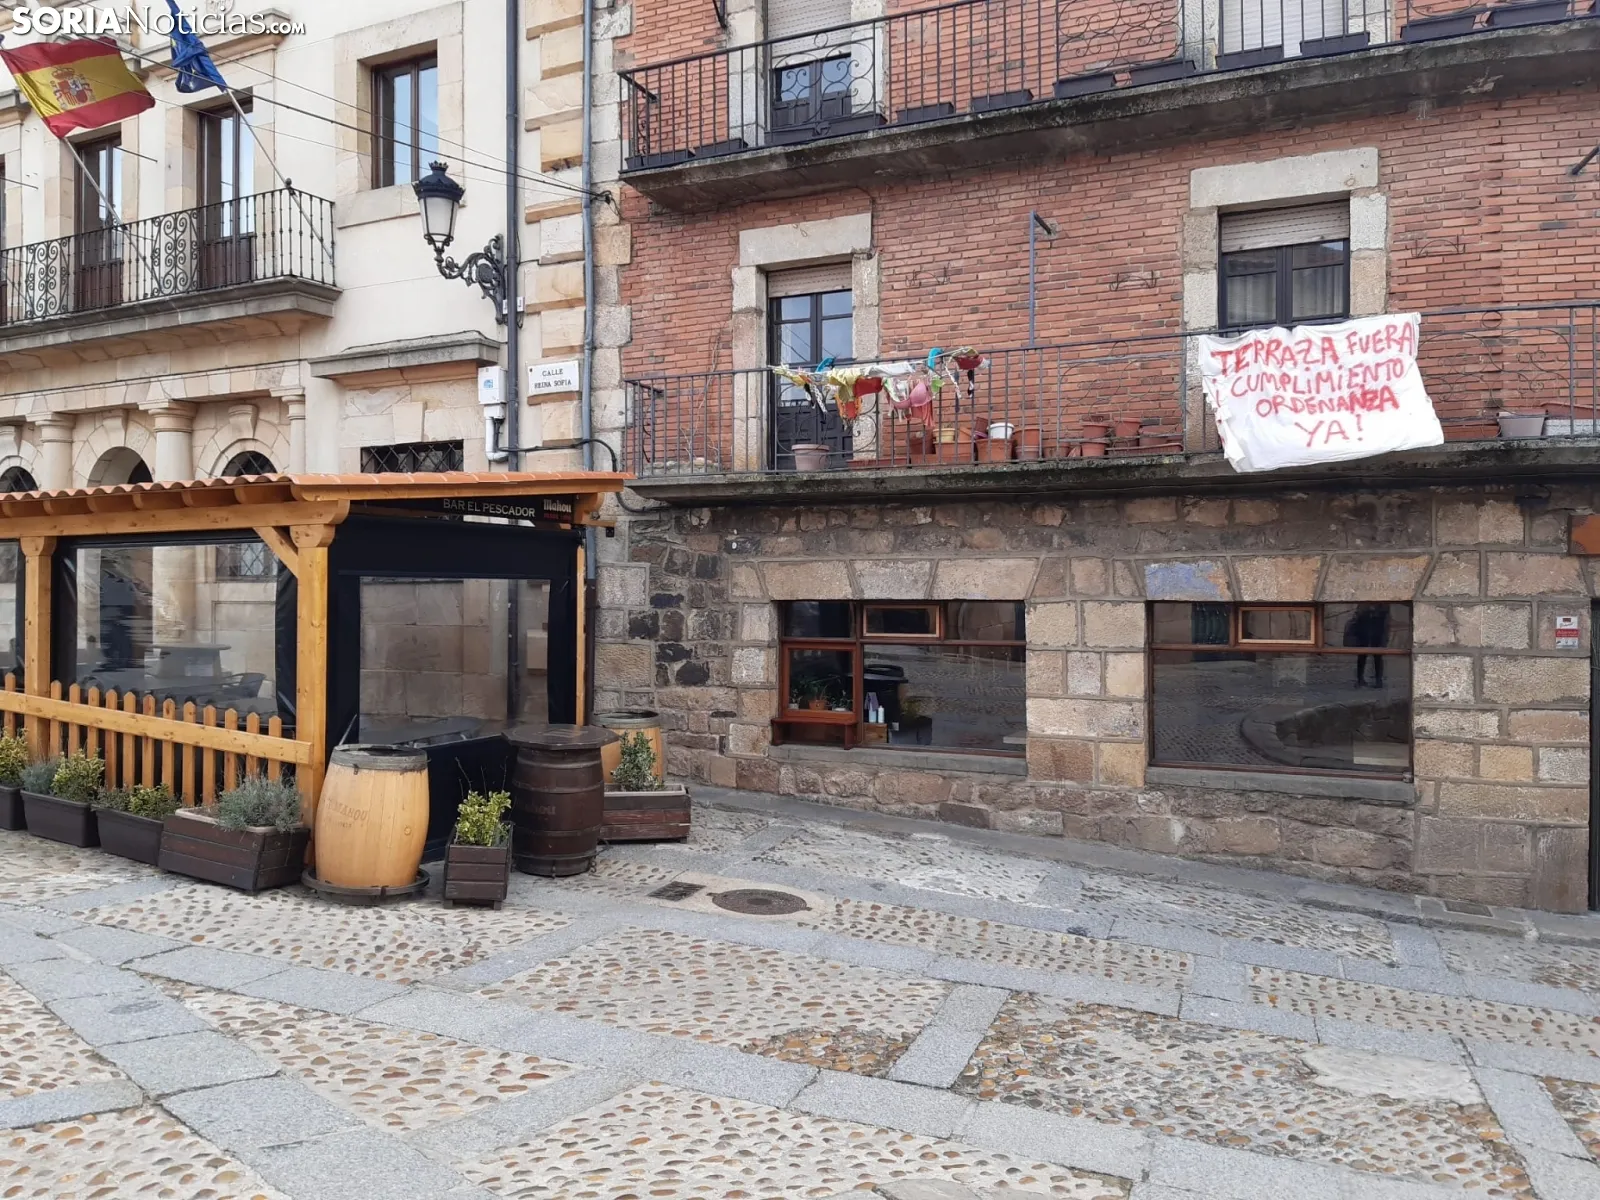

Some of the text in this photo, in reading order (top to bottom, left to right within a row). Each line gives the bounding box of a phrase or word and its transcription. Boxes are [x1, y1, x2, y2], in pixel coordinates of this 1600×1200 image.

[1211, 322, 1412, 376] TERRAZA FUERA
[542, 368, 563, 377] CALLE
[534, 381, 551, 390] REINA
[1295, 414, 1363, 447] YA!
[443, 499, 465, 511] BAR
[467, 502, 481, 512] EL
[482, 503, 536, 518] PESCADOR
[543, 498, 572, 513] Mahou
